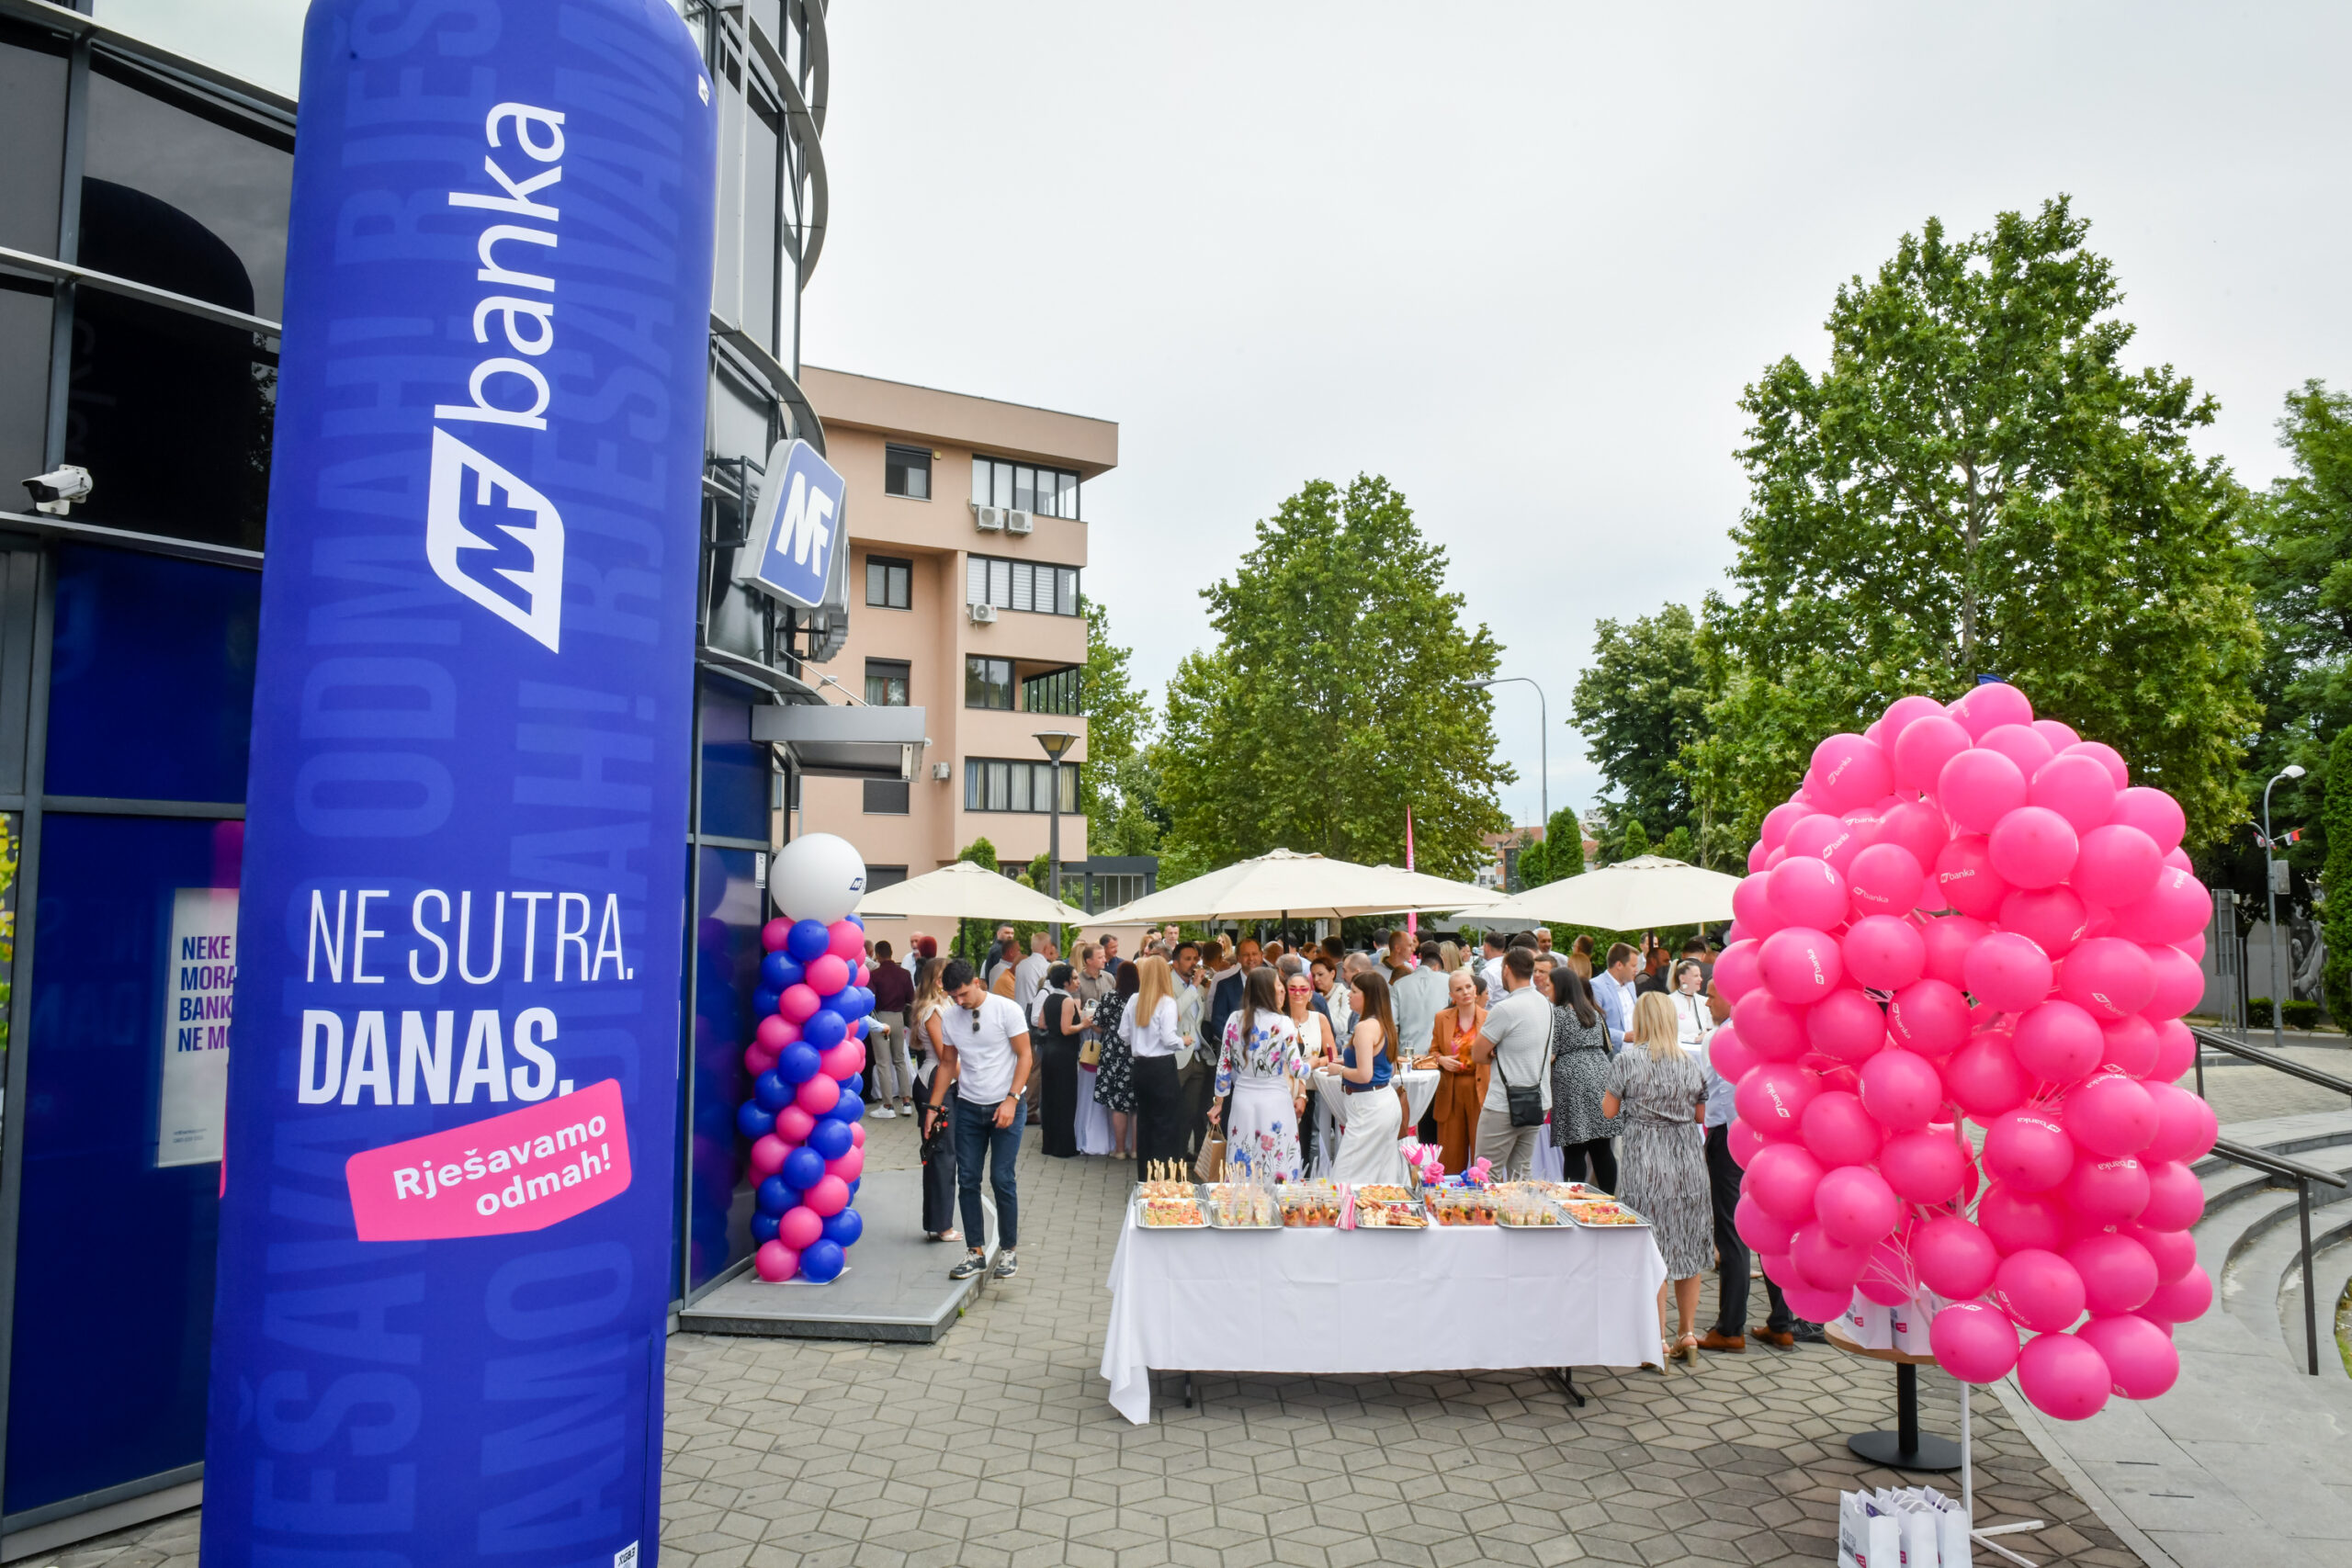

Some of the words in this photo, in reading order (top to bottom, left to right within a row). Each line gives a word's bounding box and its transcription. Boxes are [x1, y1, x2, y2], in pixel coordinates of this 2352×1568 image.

[434, 102, 566, 431] banka
[775, 470, 834, 577] MF
[1949, 868, 1975, 880] banka
[182, 936, 231, 960] NEKE
[307, 889, 390, 984] NE
[409, 888, 634, 985] SUTRA.
[177, 1027, 204, 1053] NE
[298, 1007, 574, 1105] DANAS.
[393, 1115, 606, 1200] Rješavamo
[2017, 1117, 2047, 1128] banka
[476, 1143, 611, 1215] odmah!
